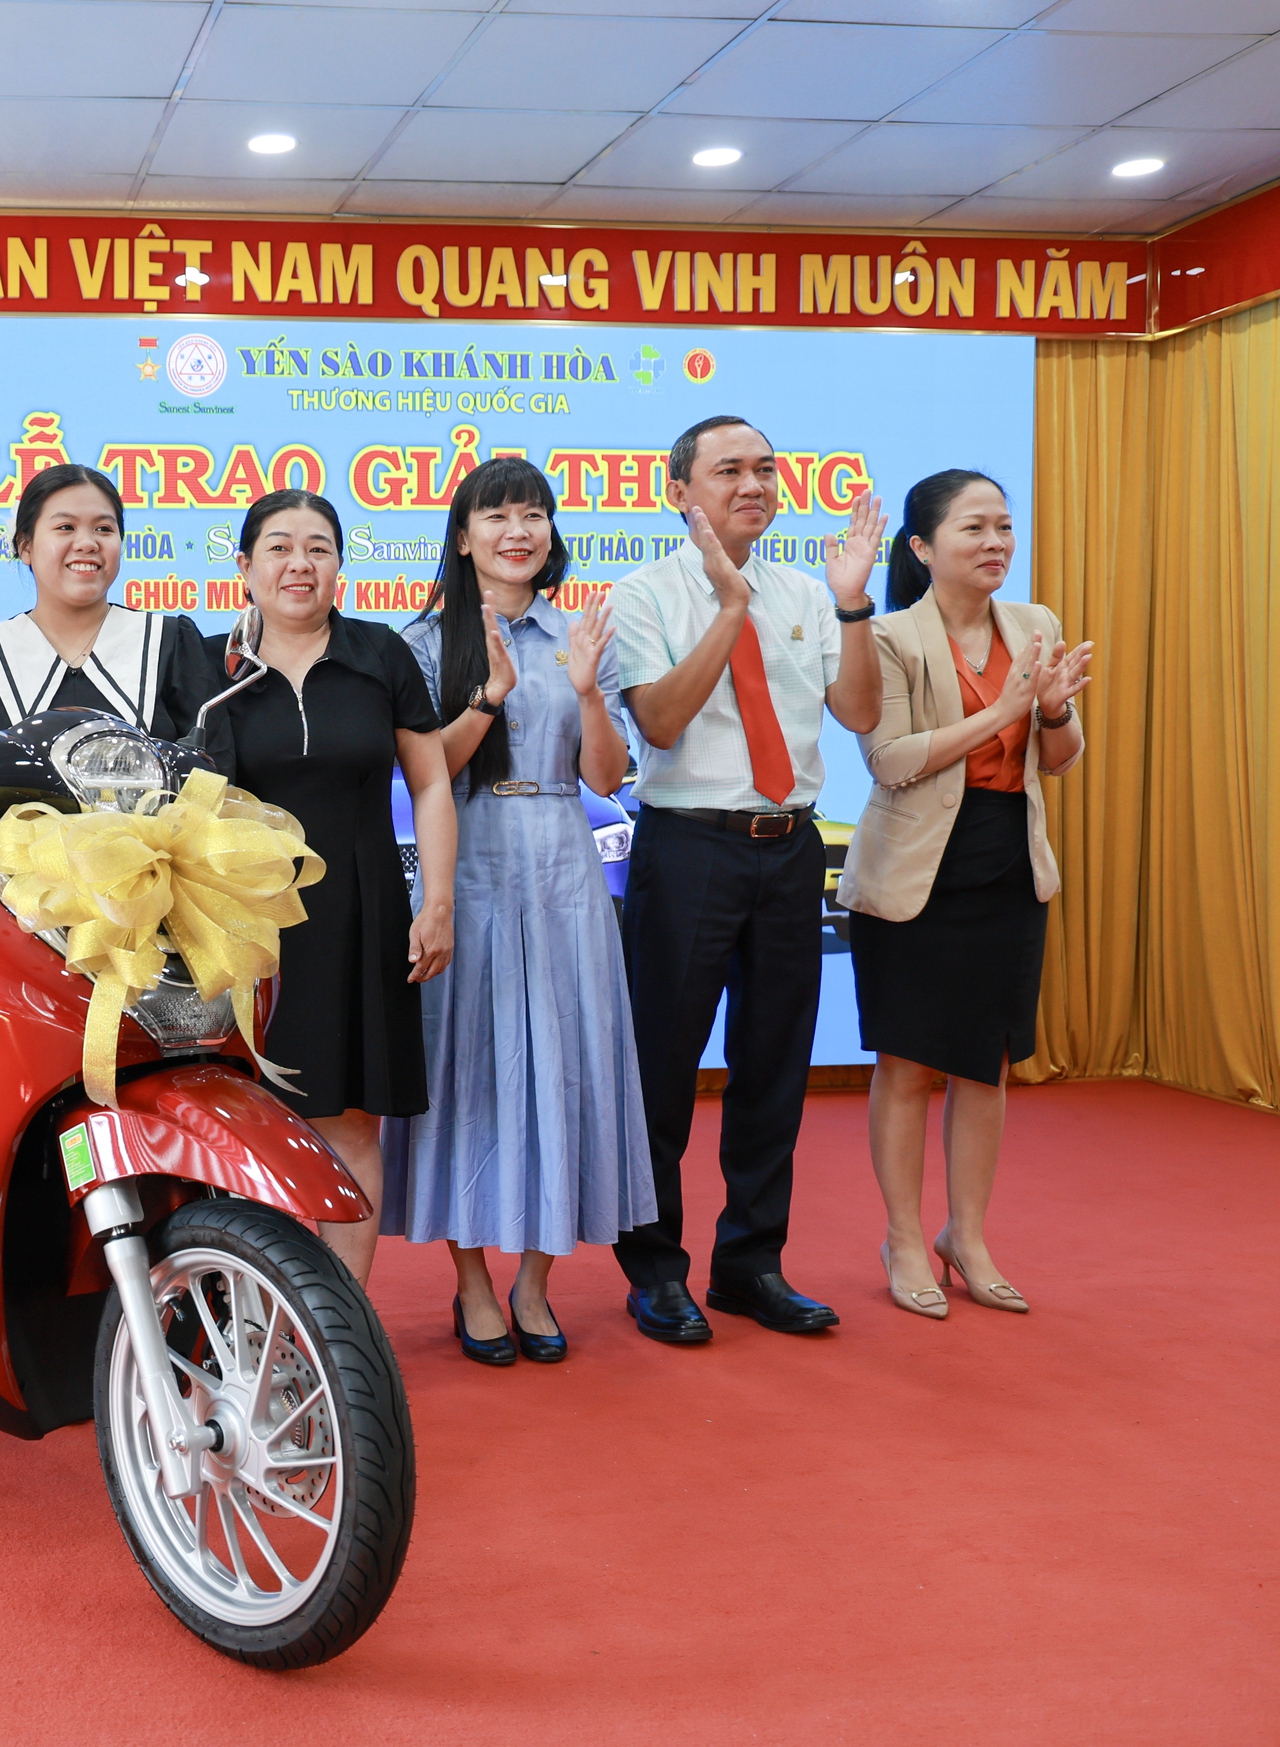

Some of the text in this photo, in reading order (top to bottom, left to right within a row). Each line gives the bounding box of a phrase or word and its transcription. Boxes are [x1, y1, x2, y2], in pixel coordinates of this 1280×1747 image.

[69, 223, 213, 312] VIỆT
[231, 240, 373, 304] NAM
[396, 244, 609, 318] QUANG
[632, 250, 776, 312] VINH
[800, 240, 975, 317] MUÔN
[996, 247, 1128, 320] NĂM
[236, 336, 310, 377] YẾN
[320, 342, 392, 377] SÀO
[401, 343, 532, 380] KHÁNH
[540, 345, 619, 382] HÒA
[159, 401, 235, 414] Sanest Sanvinest
[288, 386, 570, 418] THƯƠNG HIỆU QUỐC GIA
[101, 446, 323, 506] TRAO
[565, 534, 595, 567] TỰ
[599, 530, 644, 562] HÀO
[125, 574, 198, 611] CHÚC
